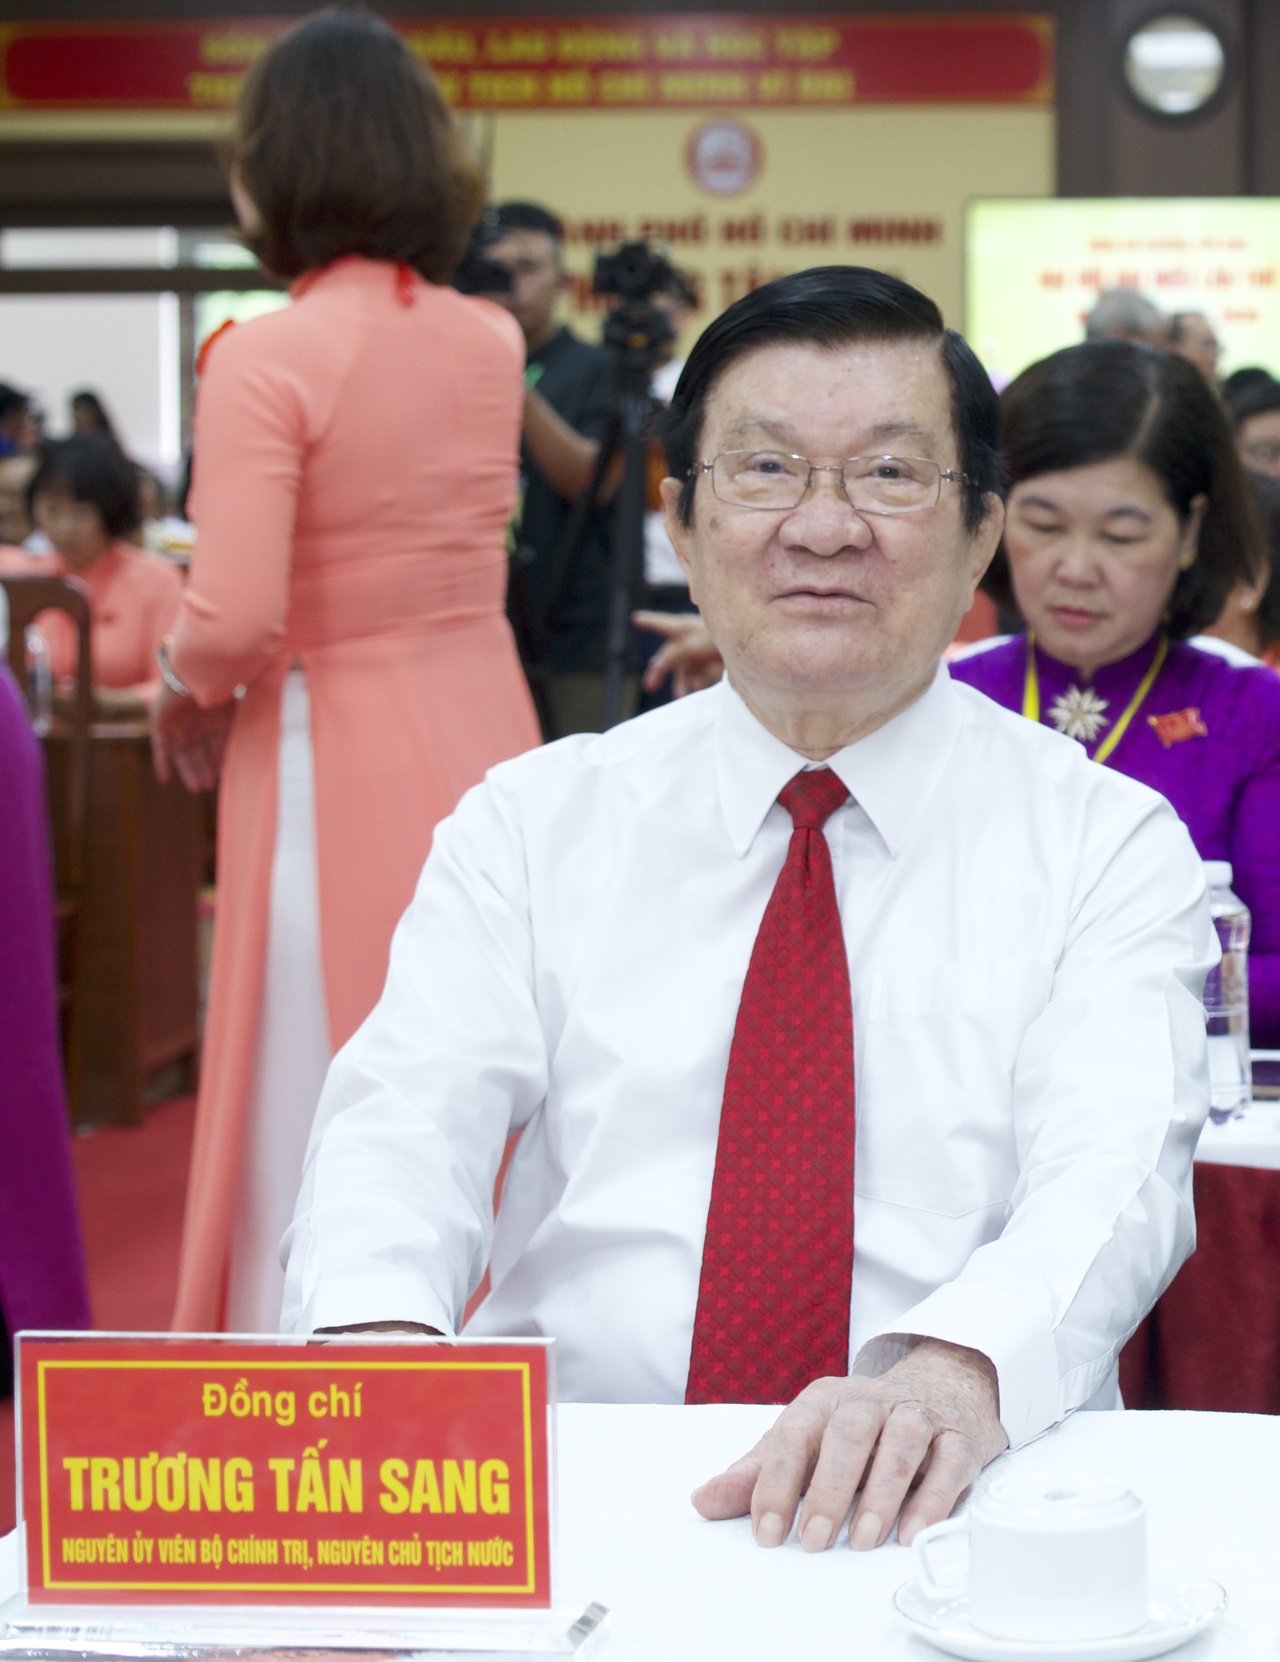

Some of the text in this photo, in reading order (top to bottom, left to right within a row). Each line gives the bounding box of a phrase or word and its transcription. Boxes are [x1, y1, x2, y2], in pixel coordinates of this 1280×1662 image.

[202, 1378, 363, 1426] Đồng chí
[63, 1439, 510, 1514] TRƯƠNG TẤN SANG
[62, 1531, 514, 1571] NGUYÊN ỦY VIÊN BỘ CHÍNH TRỊ, NGUYÊN CHỦ TỊCH NƯỚC
